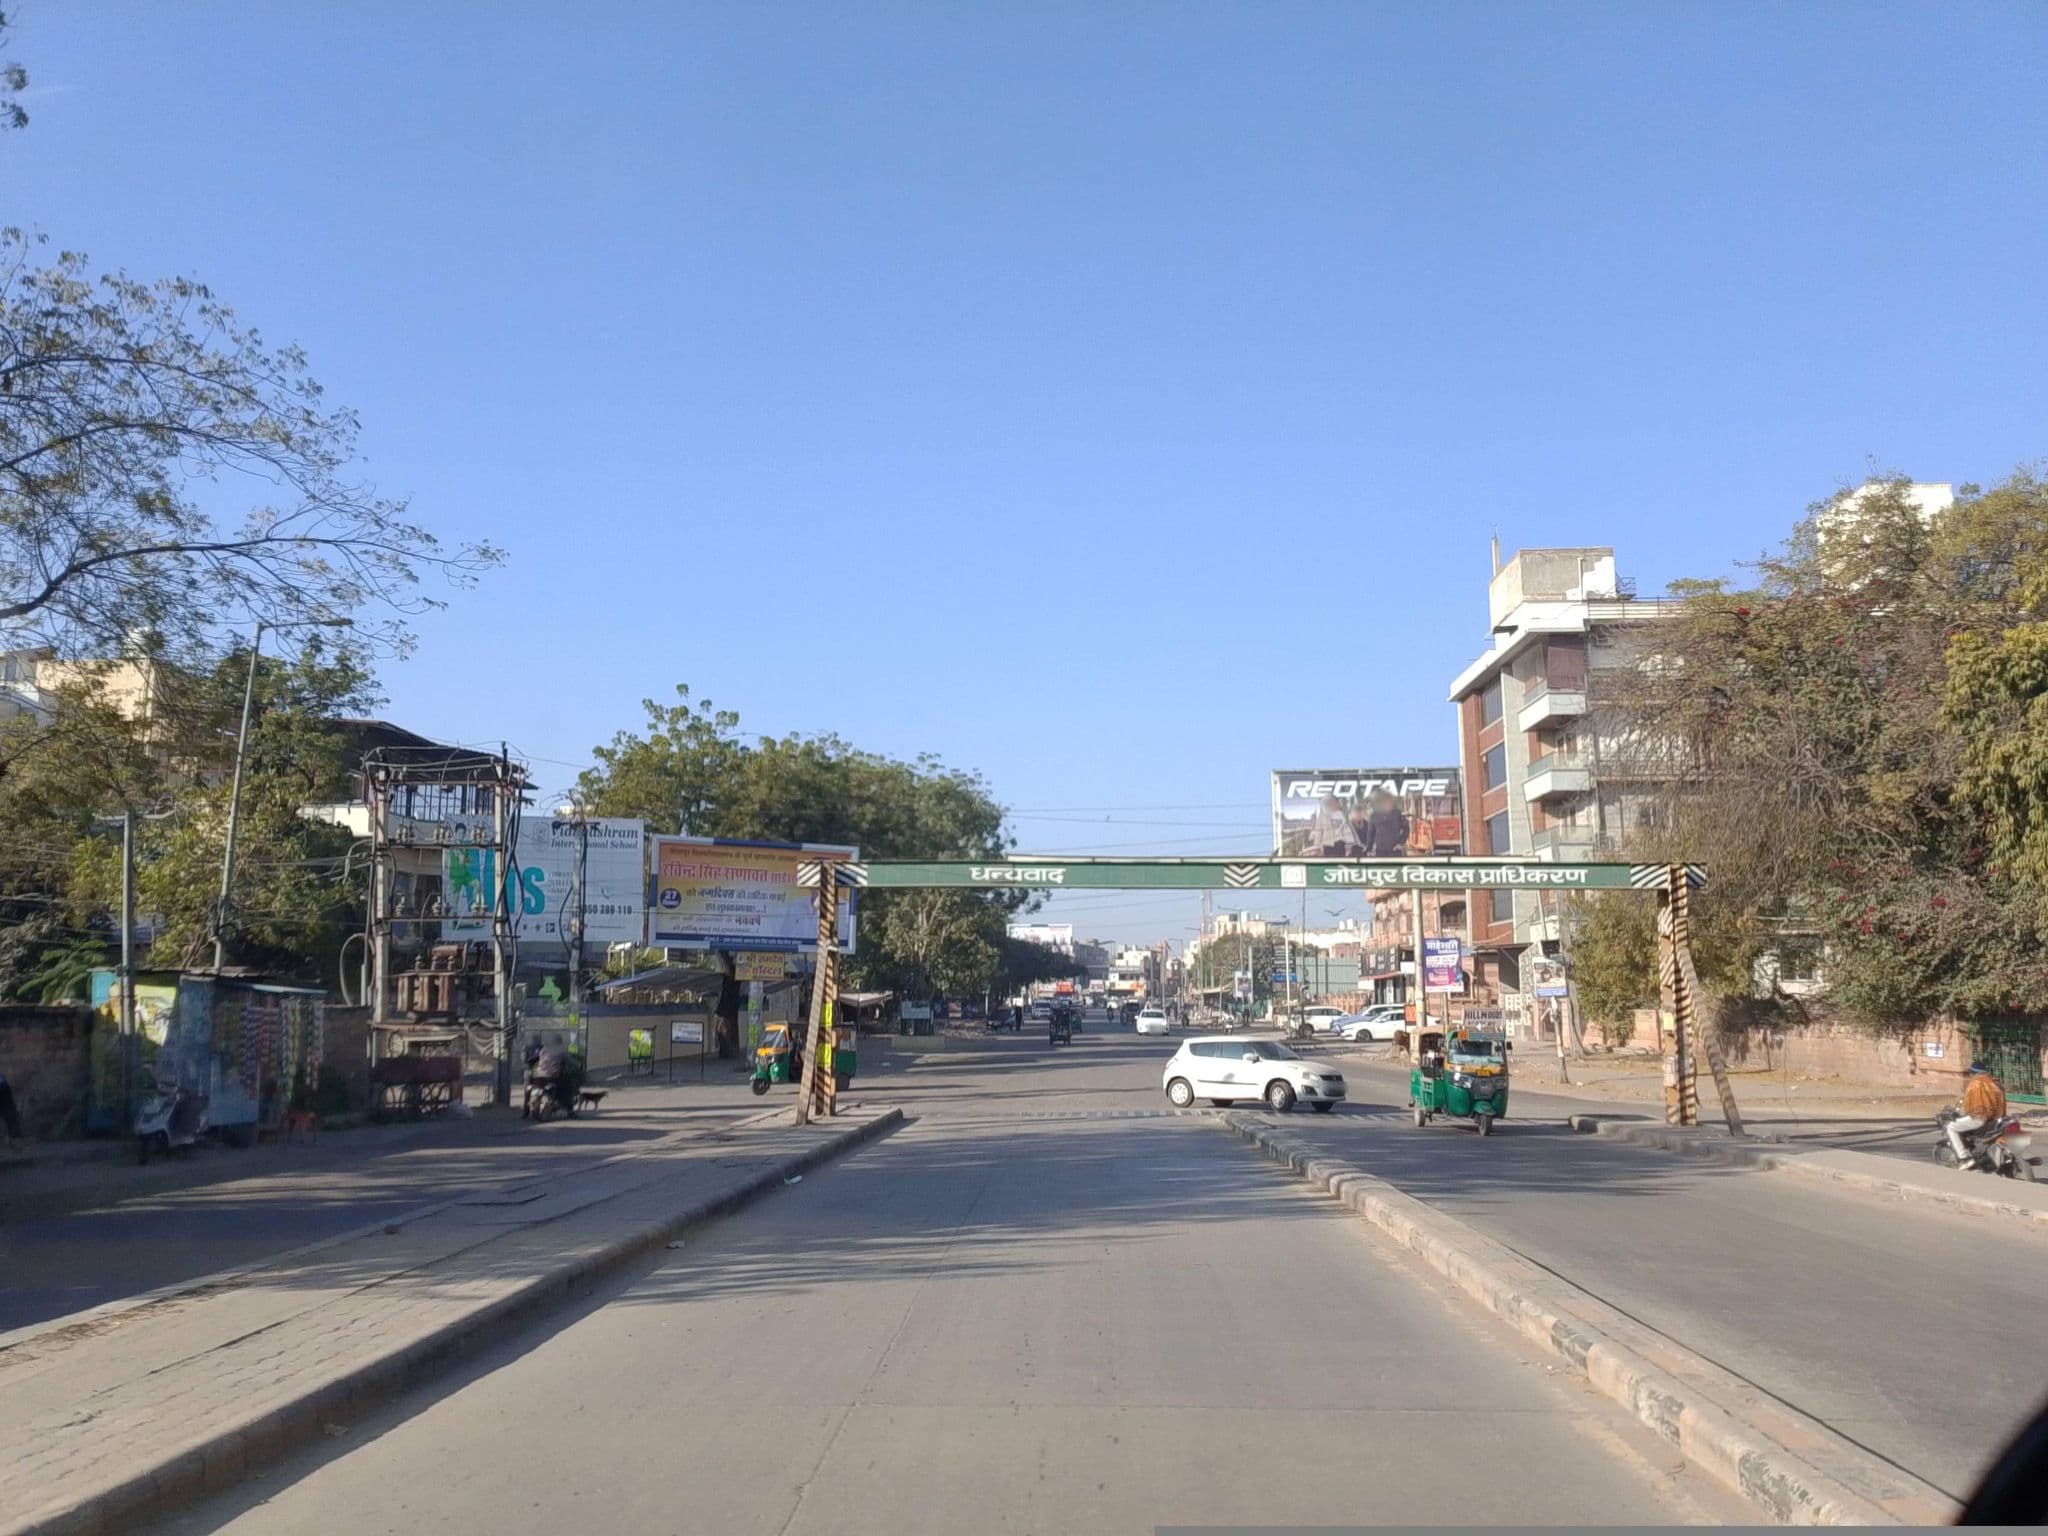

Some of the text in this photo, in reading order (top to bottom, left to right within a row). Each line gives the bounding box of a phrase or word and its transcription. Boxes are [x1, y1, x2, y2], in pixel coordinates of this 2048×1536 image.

[610, 840, 638, 849] School
[970, 866, 1066, 883] धन्यवाद
[1323, 865, 1588, 886] जोधपुर विकास प्राधिकरण
[664, 890, 677, 901] 27
[735, 914, 761, 926] नववर्ष
